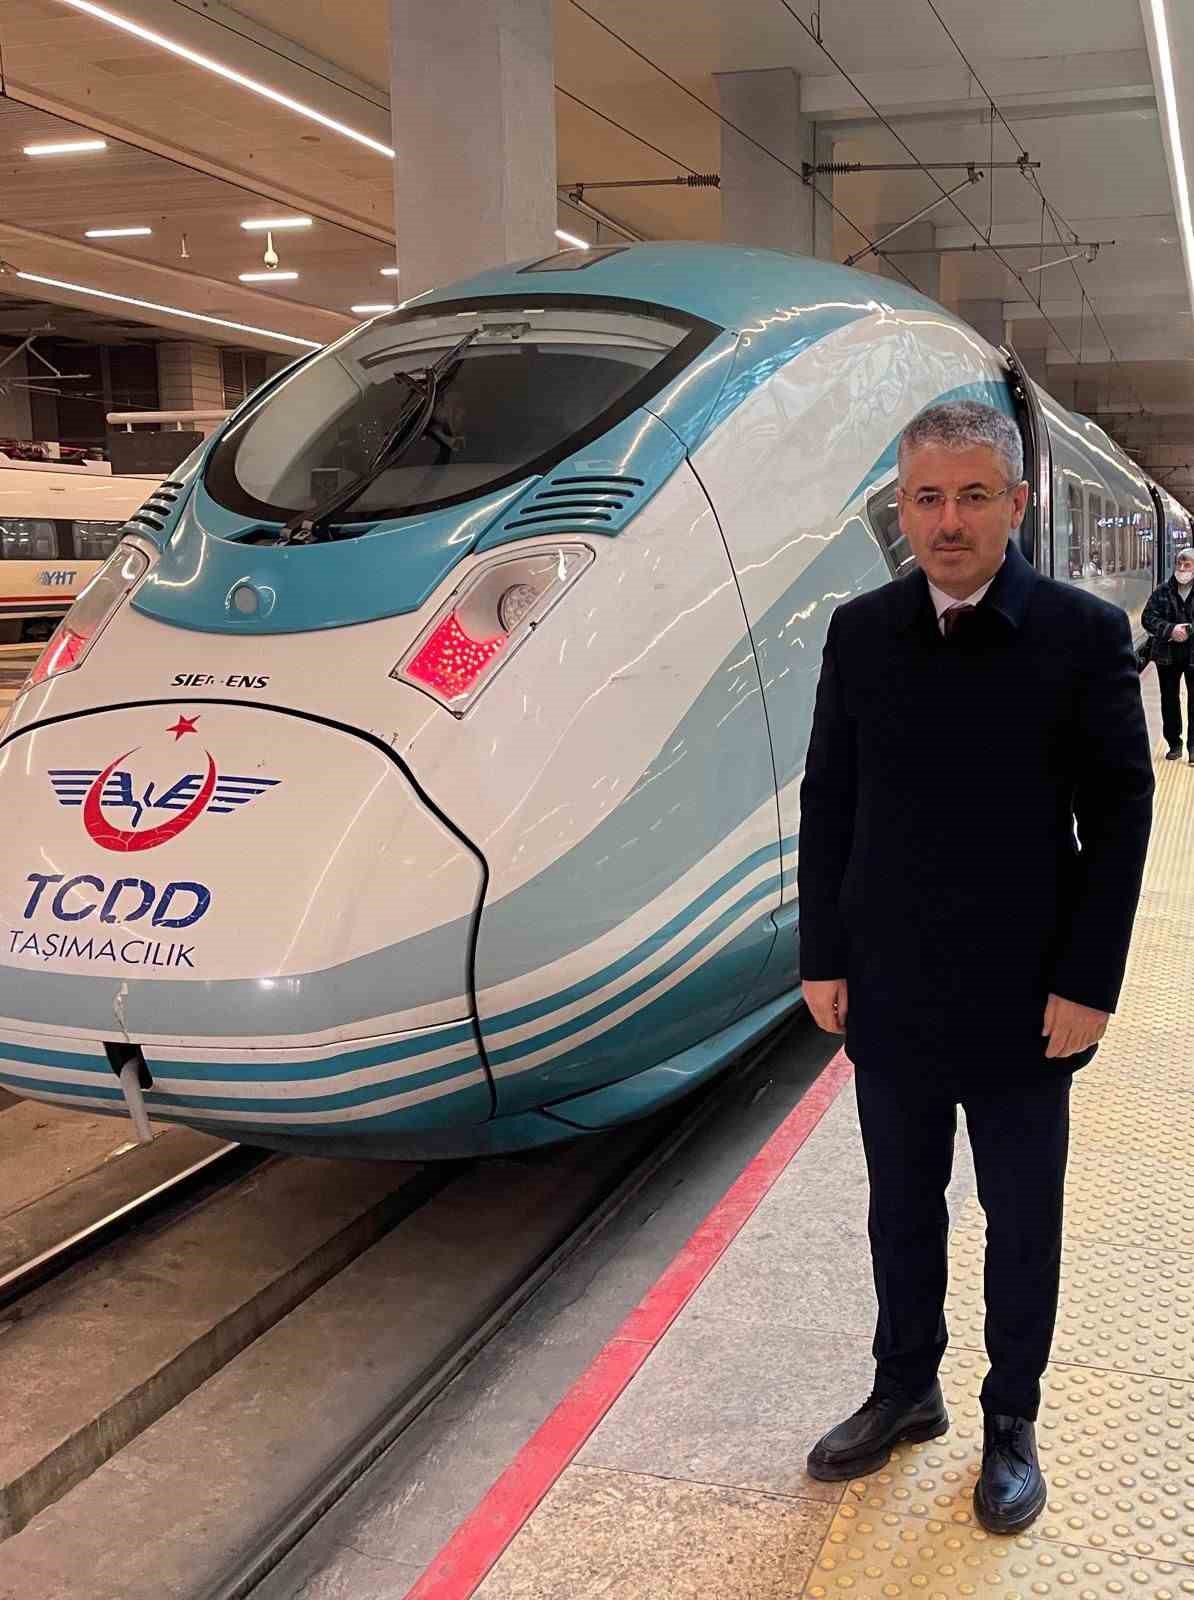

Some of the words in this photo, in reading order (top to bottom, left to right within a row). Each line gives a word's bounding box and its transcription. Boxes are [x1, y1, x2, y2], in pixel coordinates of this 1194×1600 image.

[46, 570, 77, 585] YHT
[23, 873, 211, 928] TCDD
[9, 930, 195, 968] TAŞIMACILIK
